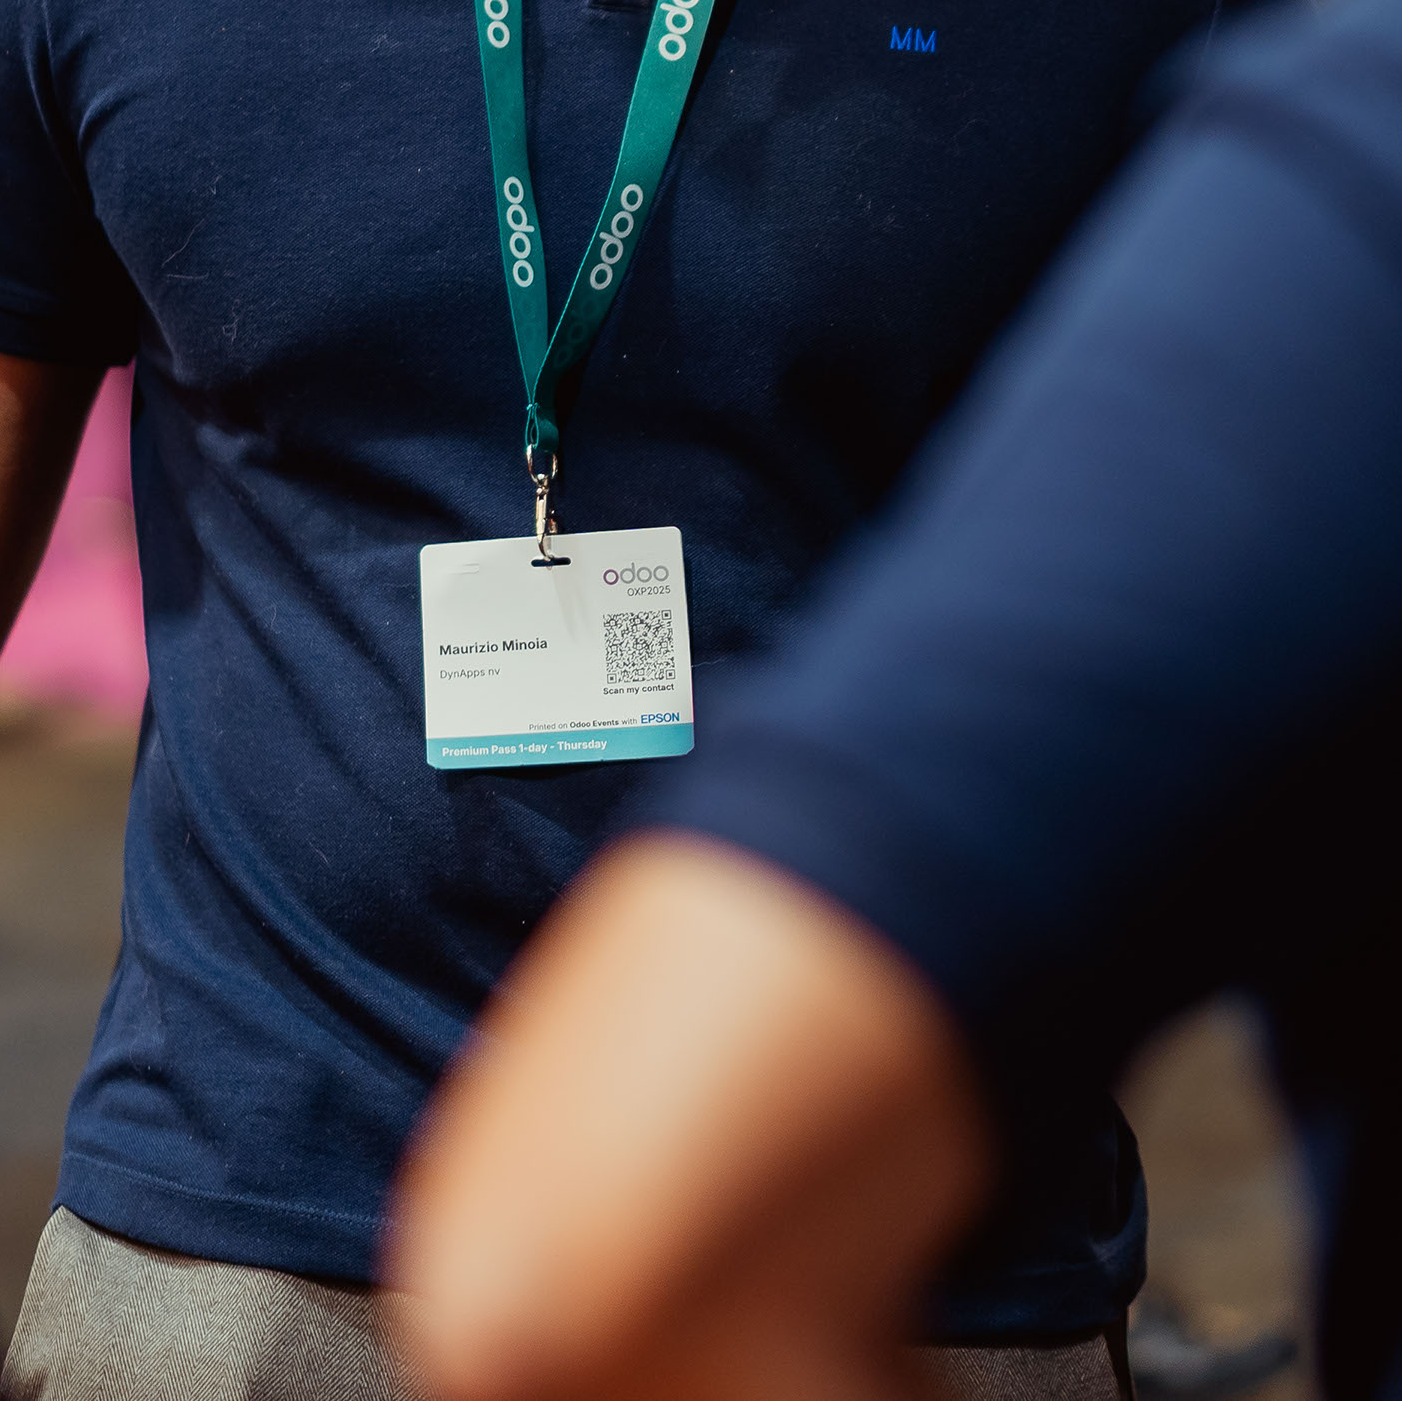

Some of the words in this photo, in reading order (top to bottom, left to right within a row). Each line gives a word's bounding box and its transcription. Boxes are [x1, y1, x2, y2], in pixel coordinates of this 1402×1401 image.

[889, 25, 937, 53] MM
[503, 176, 535, 288] odoo
[589, 183, 644, 291] odoo
[603, 562, 670, 585] odoo
[627, 585, 671, 597] OXP2025
[439, 641, 499, 656] Maurizio
[502, 637, 548, 652] Minoia
[440, 668, 486, 680] DynApps
[488, 667, 501, 676] nv
[603, 686, 625, 696] Scan
[626, 685, 640, 695] my
[642, 683, 675, 693] contact
[529, 722, 556, 731] Printed
[558, 722, 568, 730] on
[569, 720, 591, 729] Odoo
[592, 718, 619, 728] Events
[621, 716, 638, 726] with
[640, 712, 680, 724] EPSON
[442, 746, 489, 757] Premium
[491, 744, 517, 755] Pass
[519, 742, 548, 754] 1-day
[557, 738, 608, 751] Thursday
